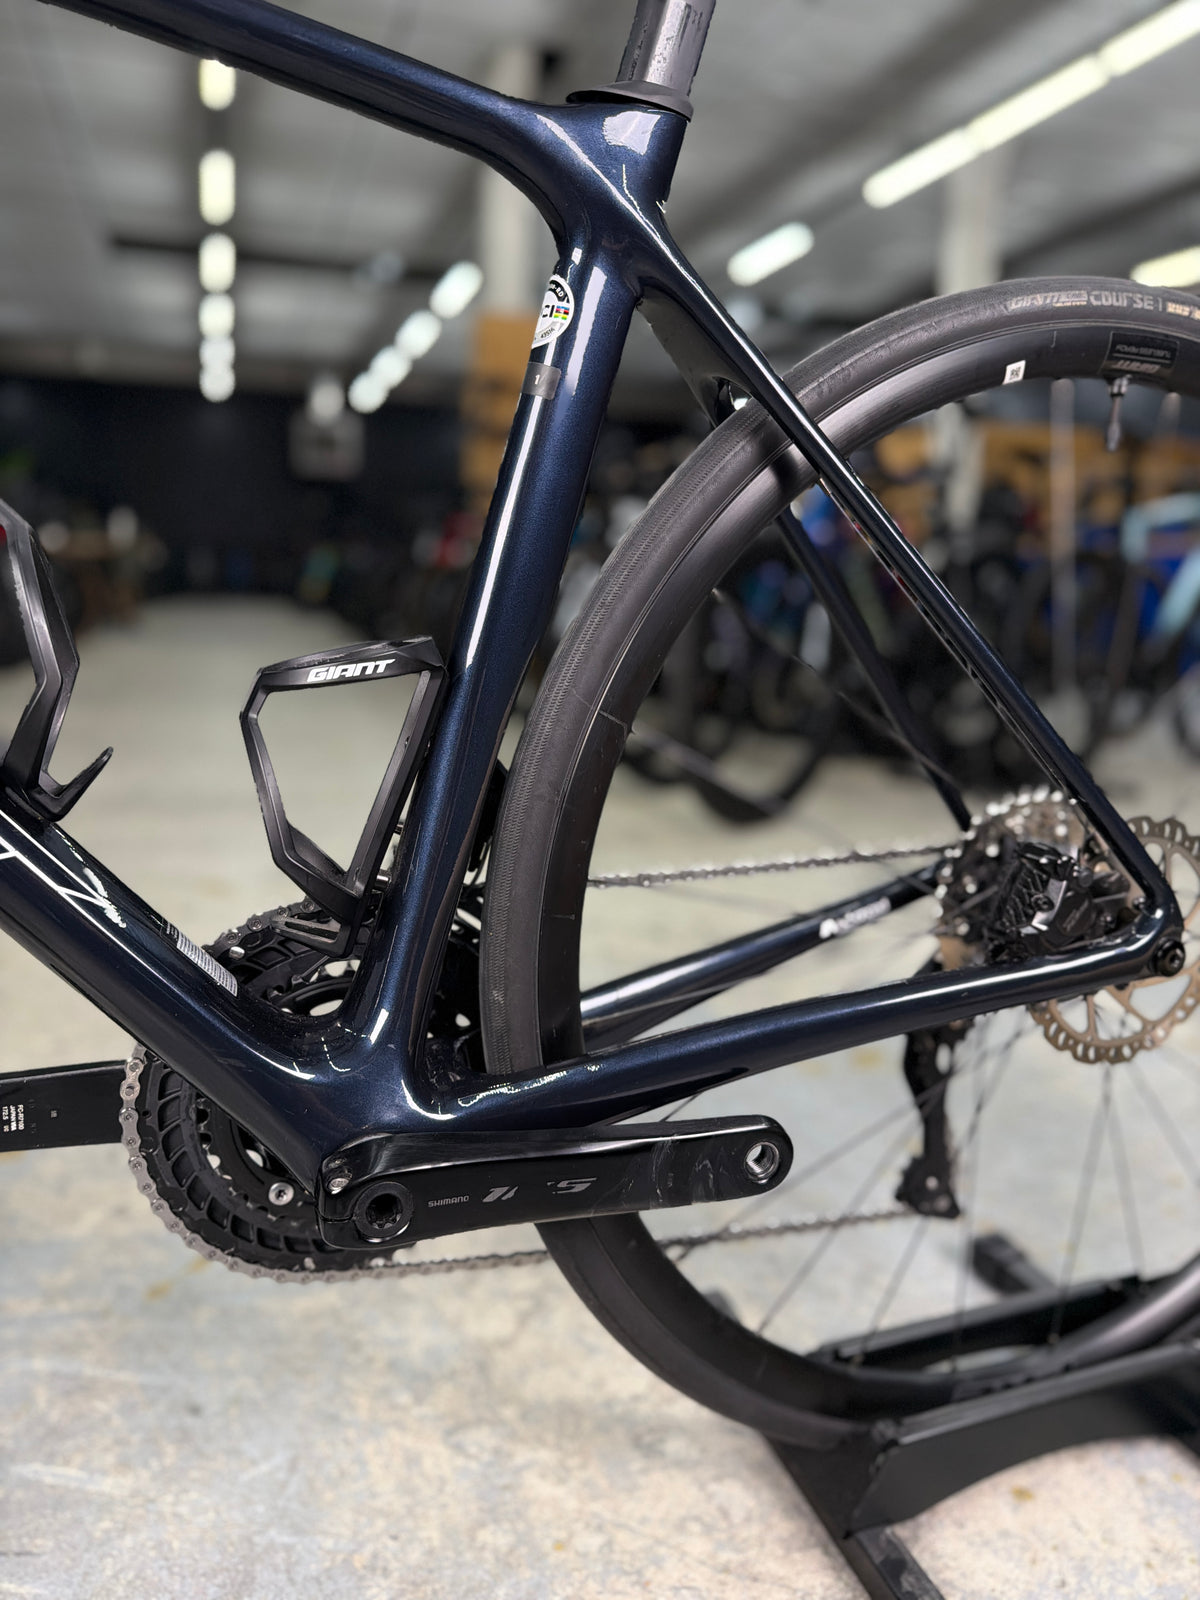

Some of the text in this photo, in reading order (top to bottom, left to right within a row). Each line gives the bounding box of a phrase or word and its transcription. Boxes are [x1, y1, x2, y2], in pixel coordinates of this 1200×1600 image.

[534, 374, 541, 385] 1
[307, 659, 396, 682] GIANT
[428, 1195, 470, 1208] SHIMANO
